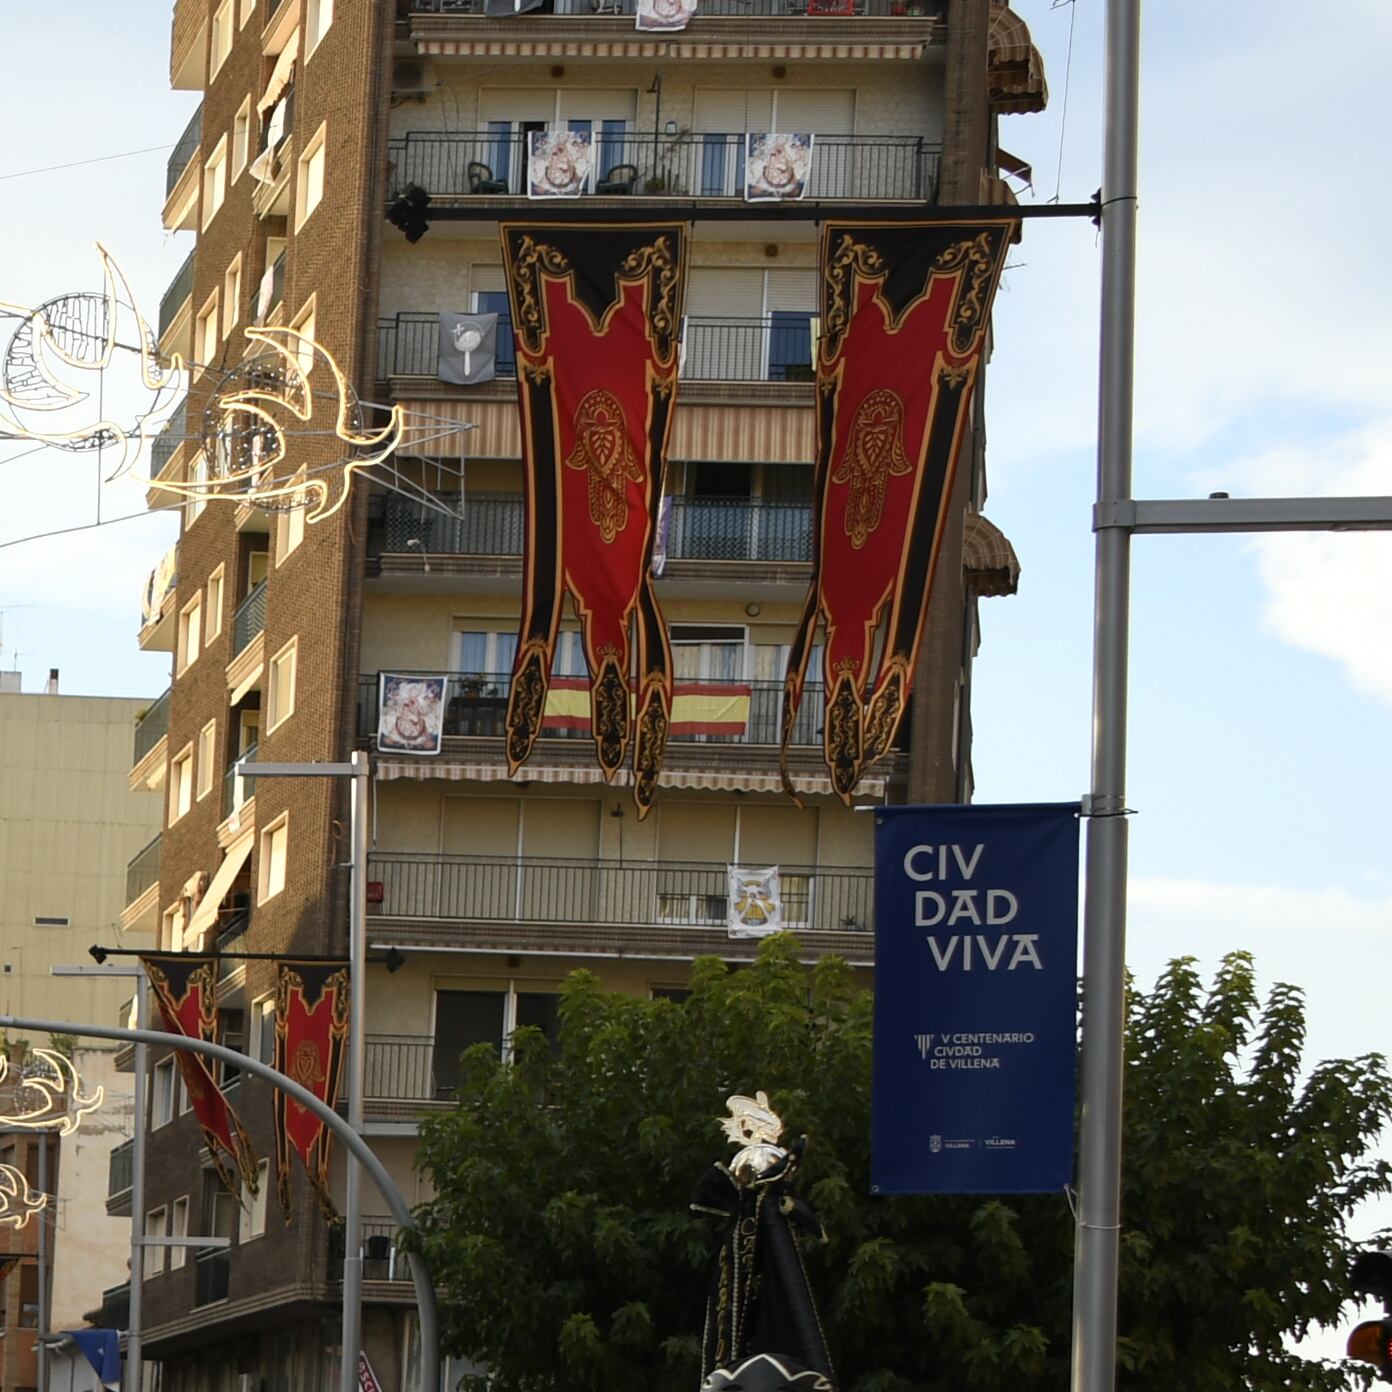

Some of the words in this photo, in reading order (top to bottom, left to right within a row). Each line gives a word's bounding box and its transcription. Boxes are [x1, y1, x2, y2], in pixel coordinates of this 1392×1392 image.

[903, 843, 985, 881] CIV
[914, 889, 1018, 927] DAD
[926, 933, 1044, 972] VIVA
[941, 1034, 951, 1044] V
[953, 1032, 1034, 1044] CENTENARIO
[930, 1059, 947, 1069] DE
[949, 1057, 1000, 1069] VILLENA
[934, 1046, 982, 1057] CIVDAD
